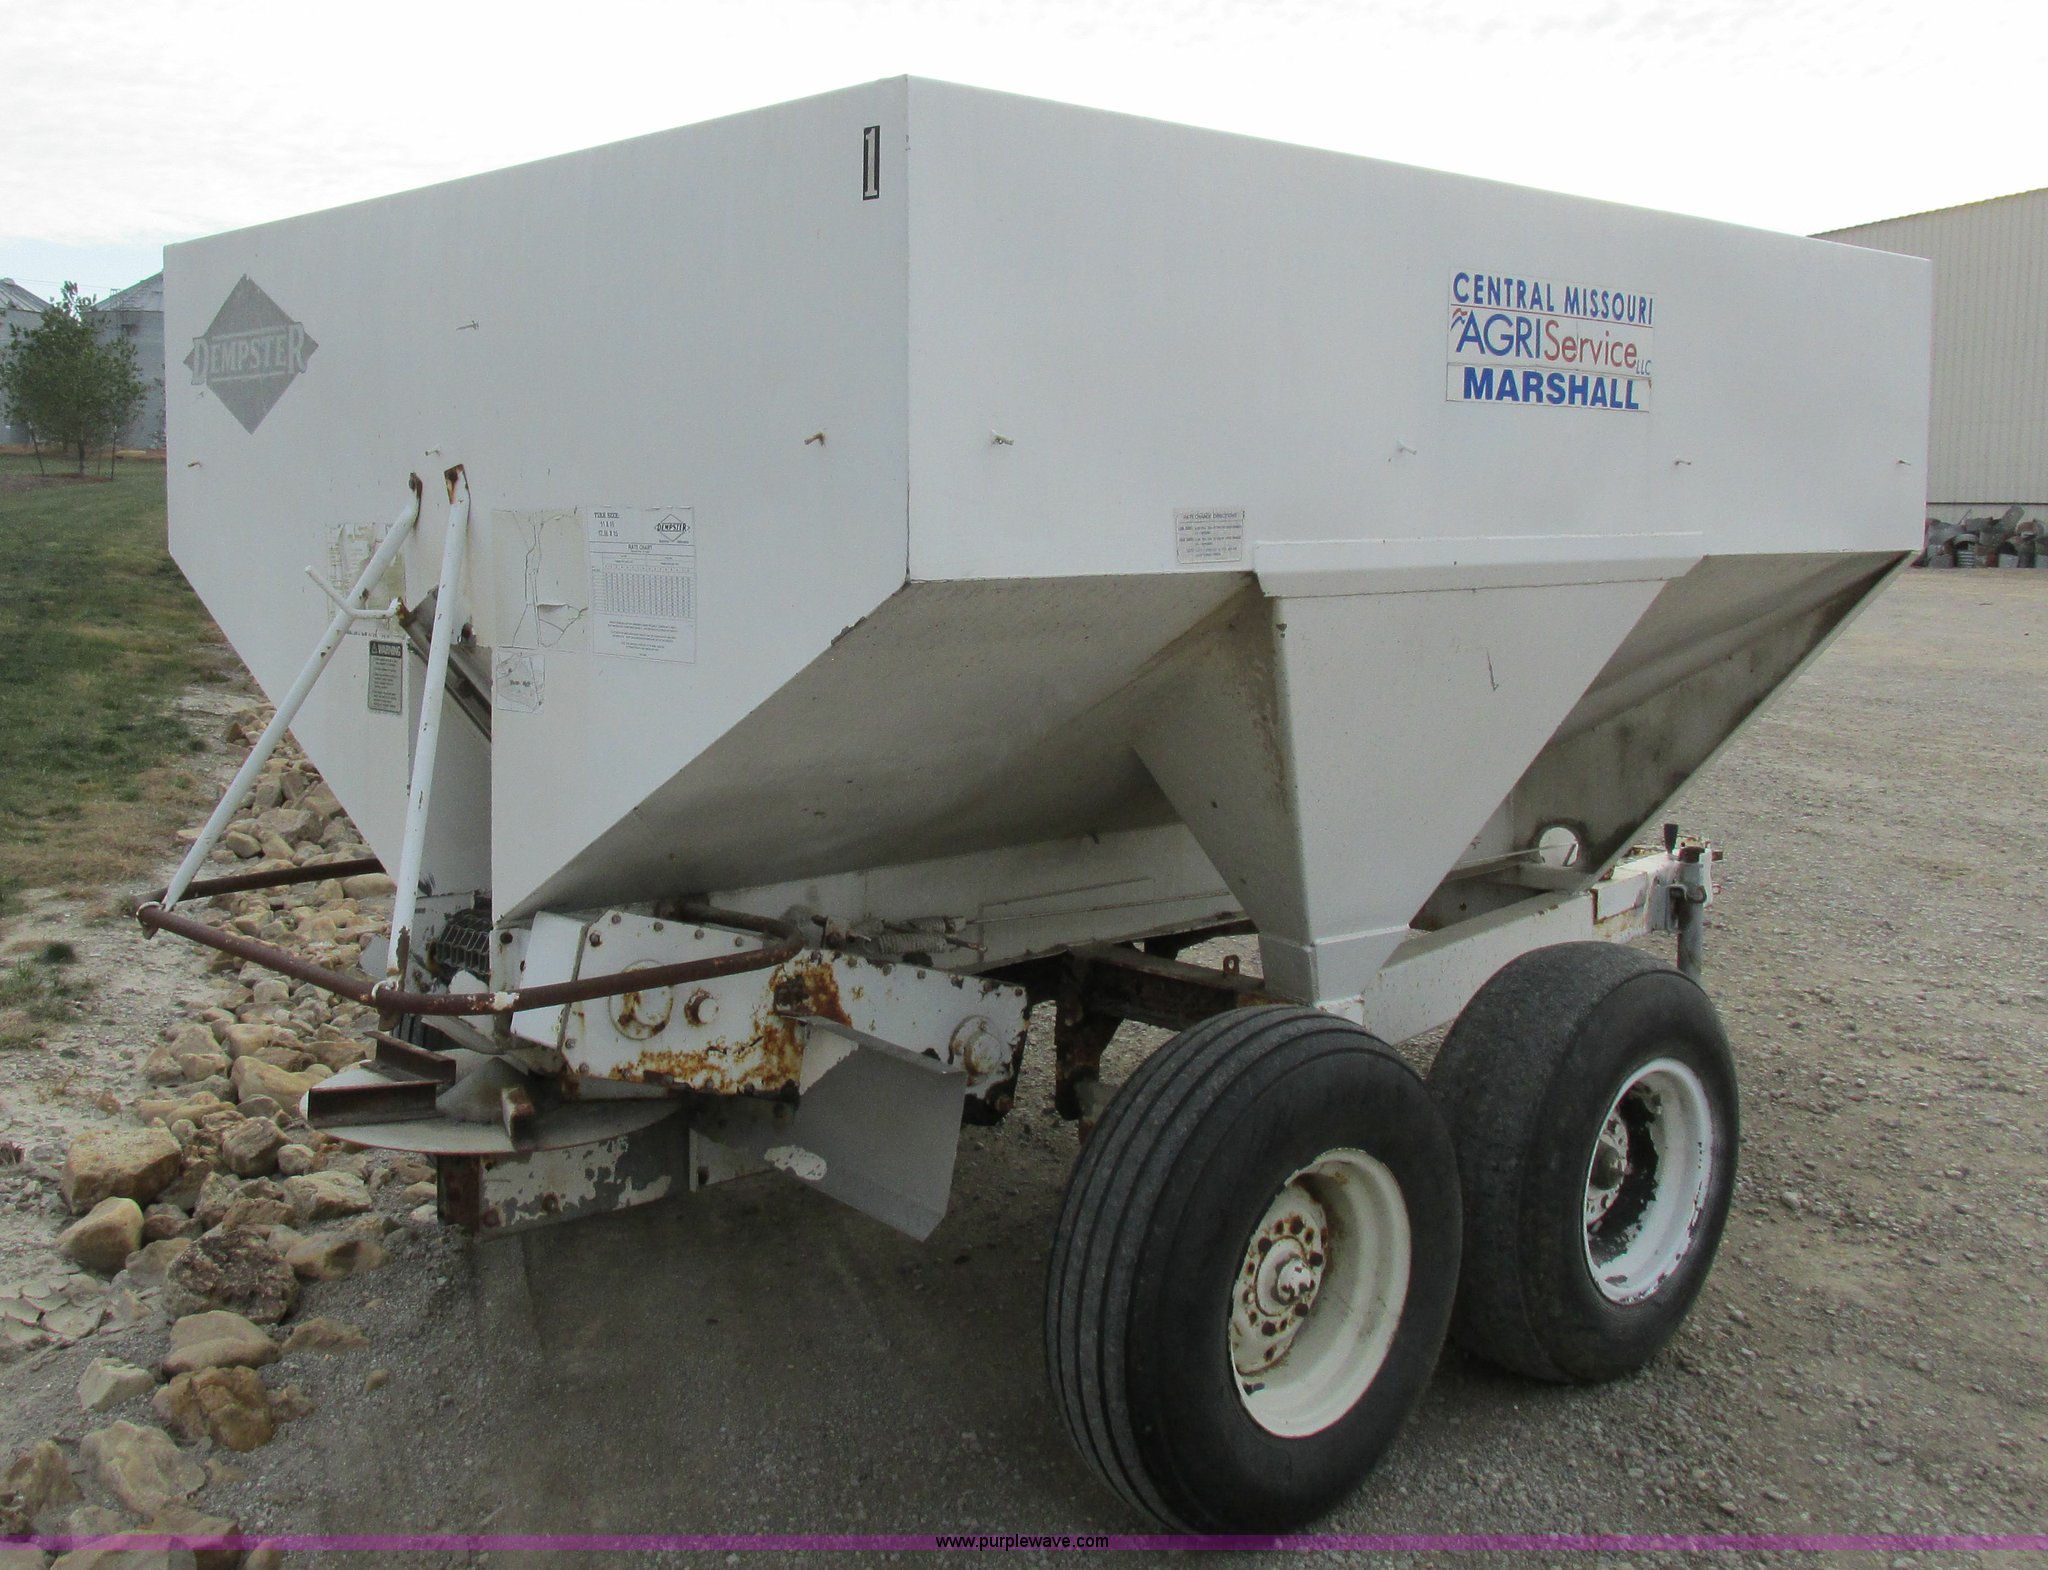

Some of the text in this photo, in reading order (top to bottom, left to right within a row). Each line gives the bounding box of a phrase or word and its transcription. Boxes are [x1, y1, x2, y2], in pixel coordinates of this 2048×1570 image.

[1452, 272, 1653, 325] CENTRAL MISSOURI
[190, 321, 307, 386] DEMPSTER
[1463, 366, 1639, 410] MARSHALL
